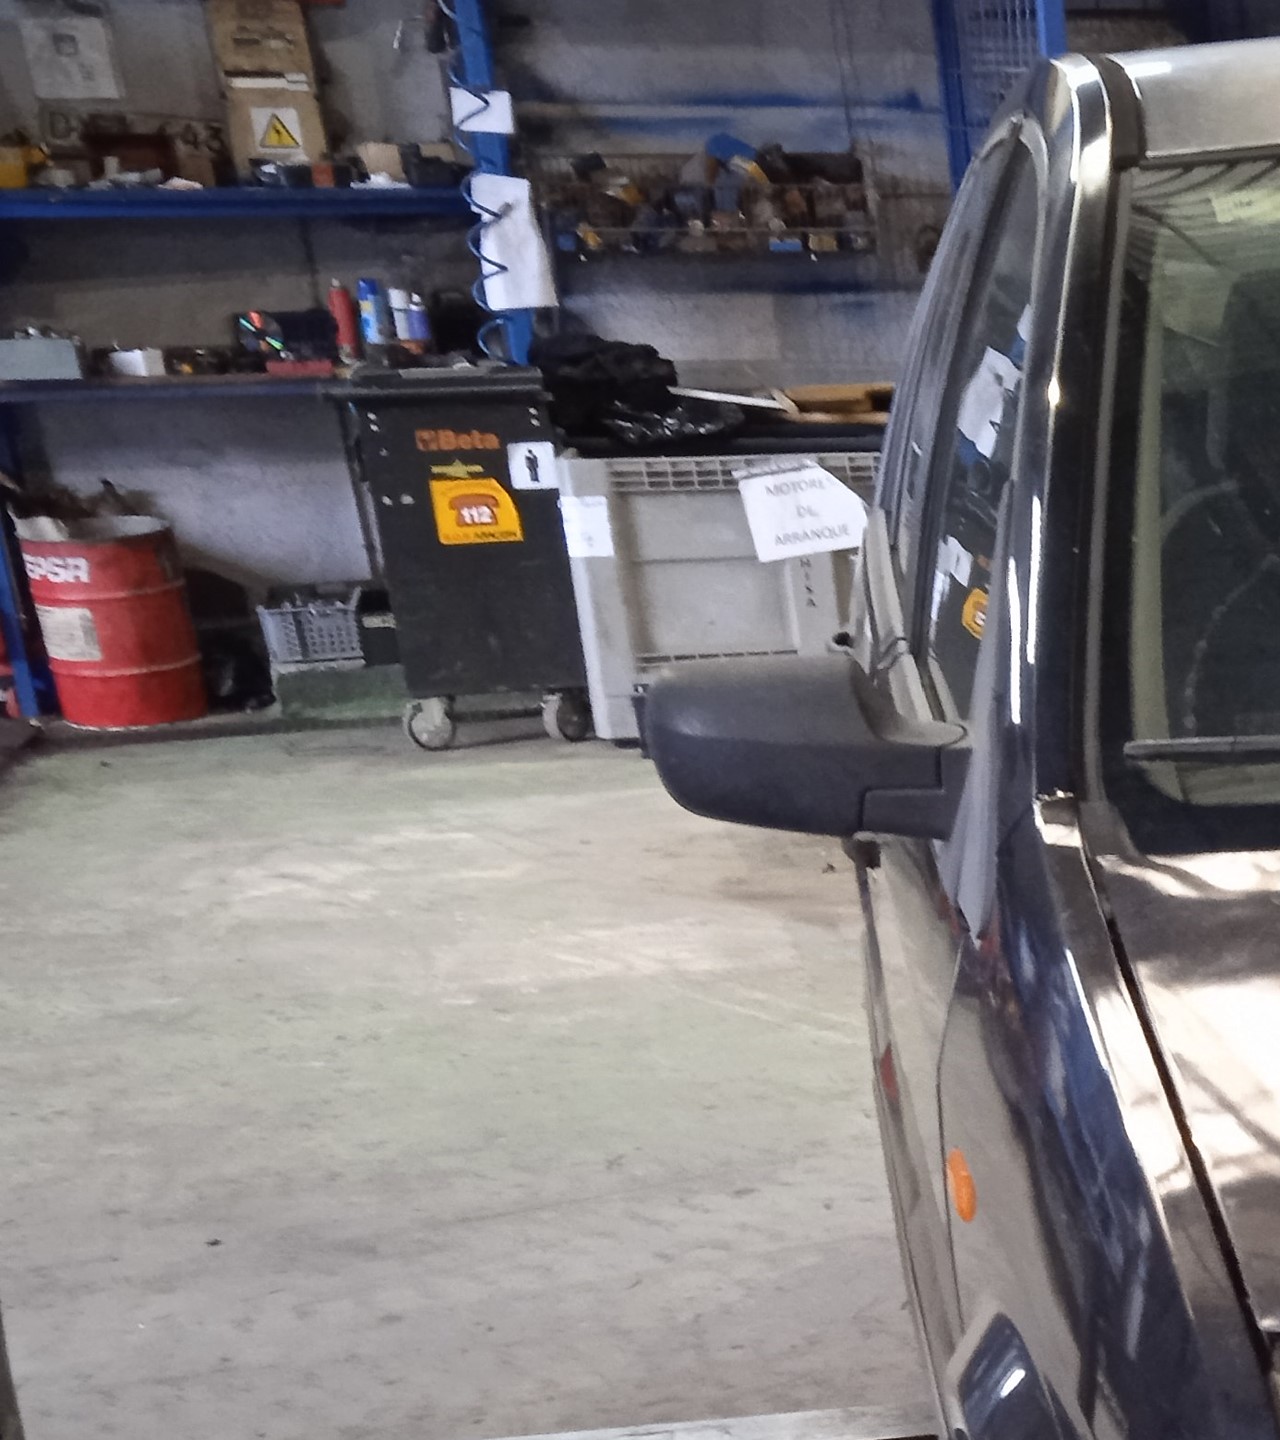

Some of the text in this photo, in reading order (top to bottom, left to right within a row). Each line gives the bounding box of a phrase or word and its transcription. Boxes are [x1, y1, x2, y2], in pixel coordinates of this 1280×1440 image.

[764, 476, 834, 497] MOTORE
[460, 504, 493, 525] 112
[774, 523, 851, 546] ARRANQUE
